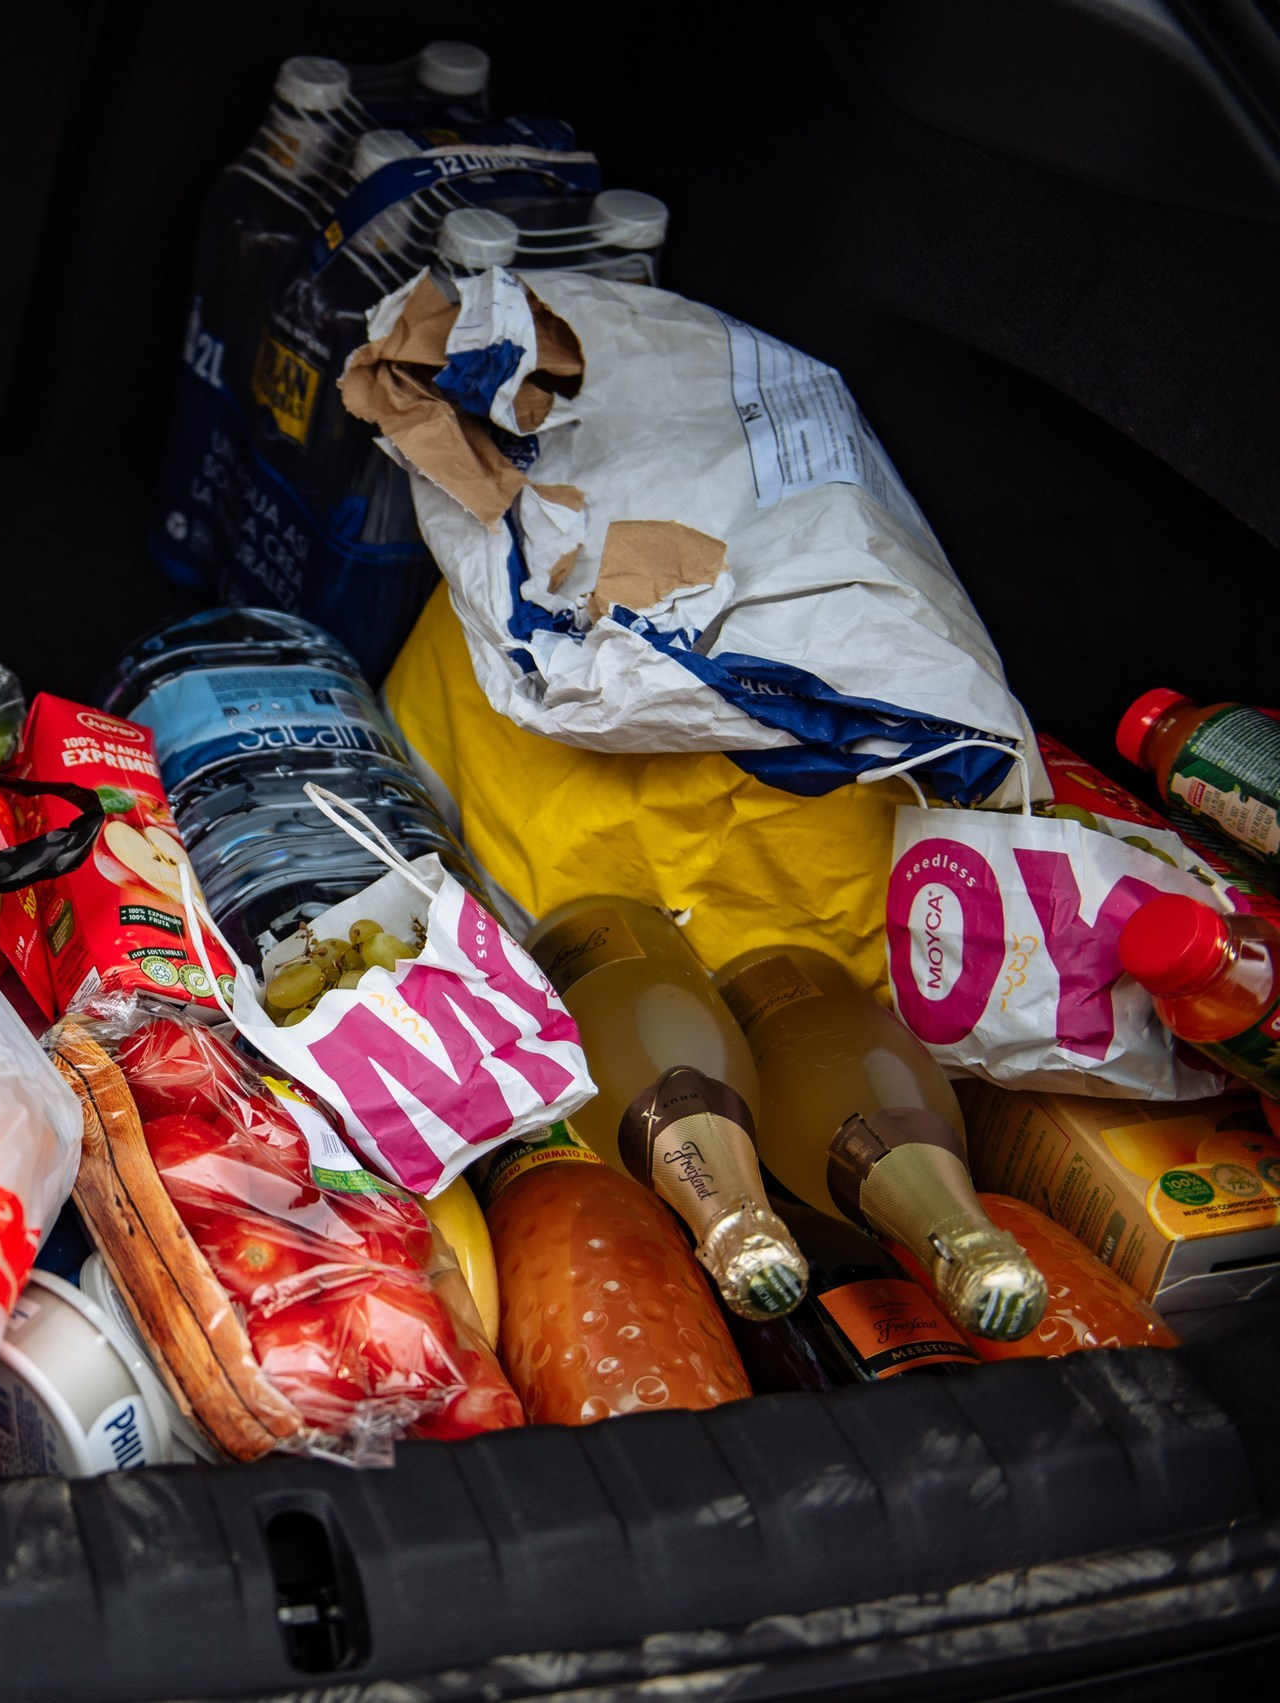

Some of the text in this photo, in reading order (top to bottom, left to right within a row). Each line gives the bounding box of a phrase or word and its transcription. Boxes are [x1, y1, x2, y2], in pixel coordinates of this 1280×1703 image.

[433, 156, 461, 176] 12
[62, 737, 100, 749] 100%
[905, 854, 977, 888] seedless
[128, 907, 181, 925] 100% EXPRIMIDO
[149, 916, 170, 928] FRUTA
[661, 1092, 699, 1110] BRUT
[531, 1149, 581, 1163] FORMATO
[664, 1141, 718, 1201] Freixenet
[1165, 1177, 1201, 1190] 100%
[1230, 1180, 1255, 1191] 72%
[1183, 1206, 1218, 1216] NUESTRO
[1218, 1198, 1266, 1210] COMPROMISO
[1206, 1211, 1221, 1219] OUR
[874, 1318, 939, 1344] Freixenet
[891, 1343, 961, 1361] MERITUM
